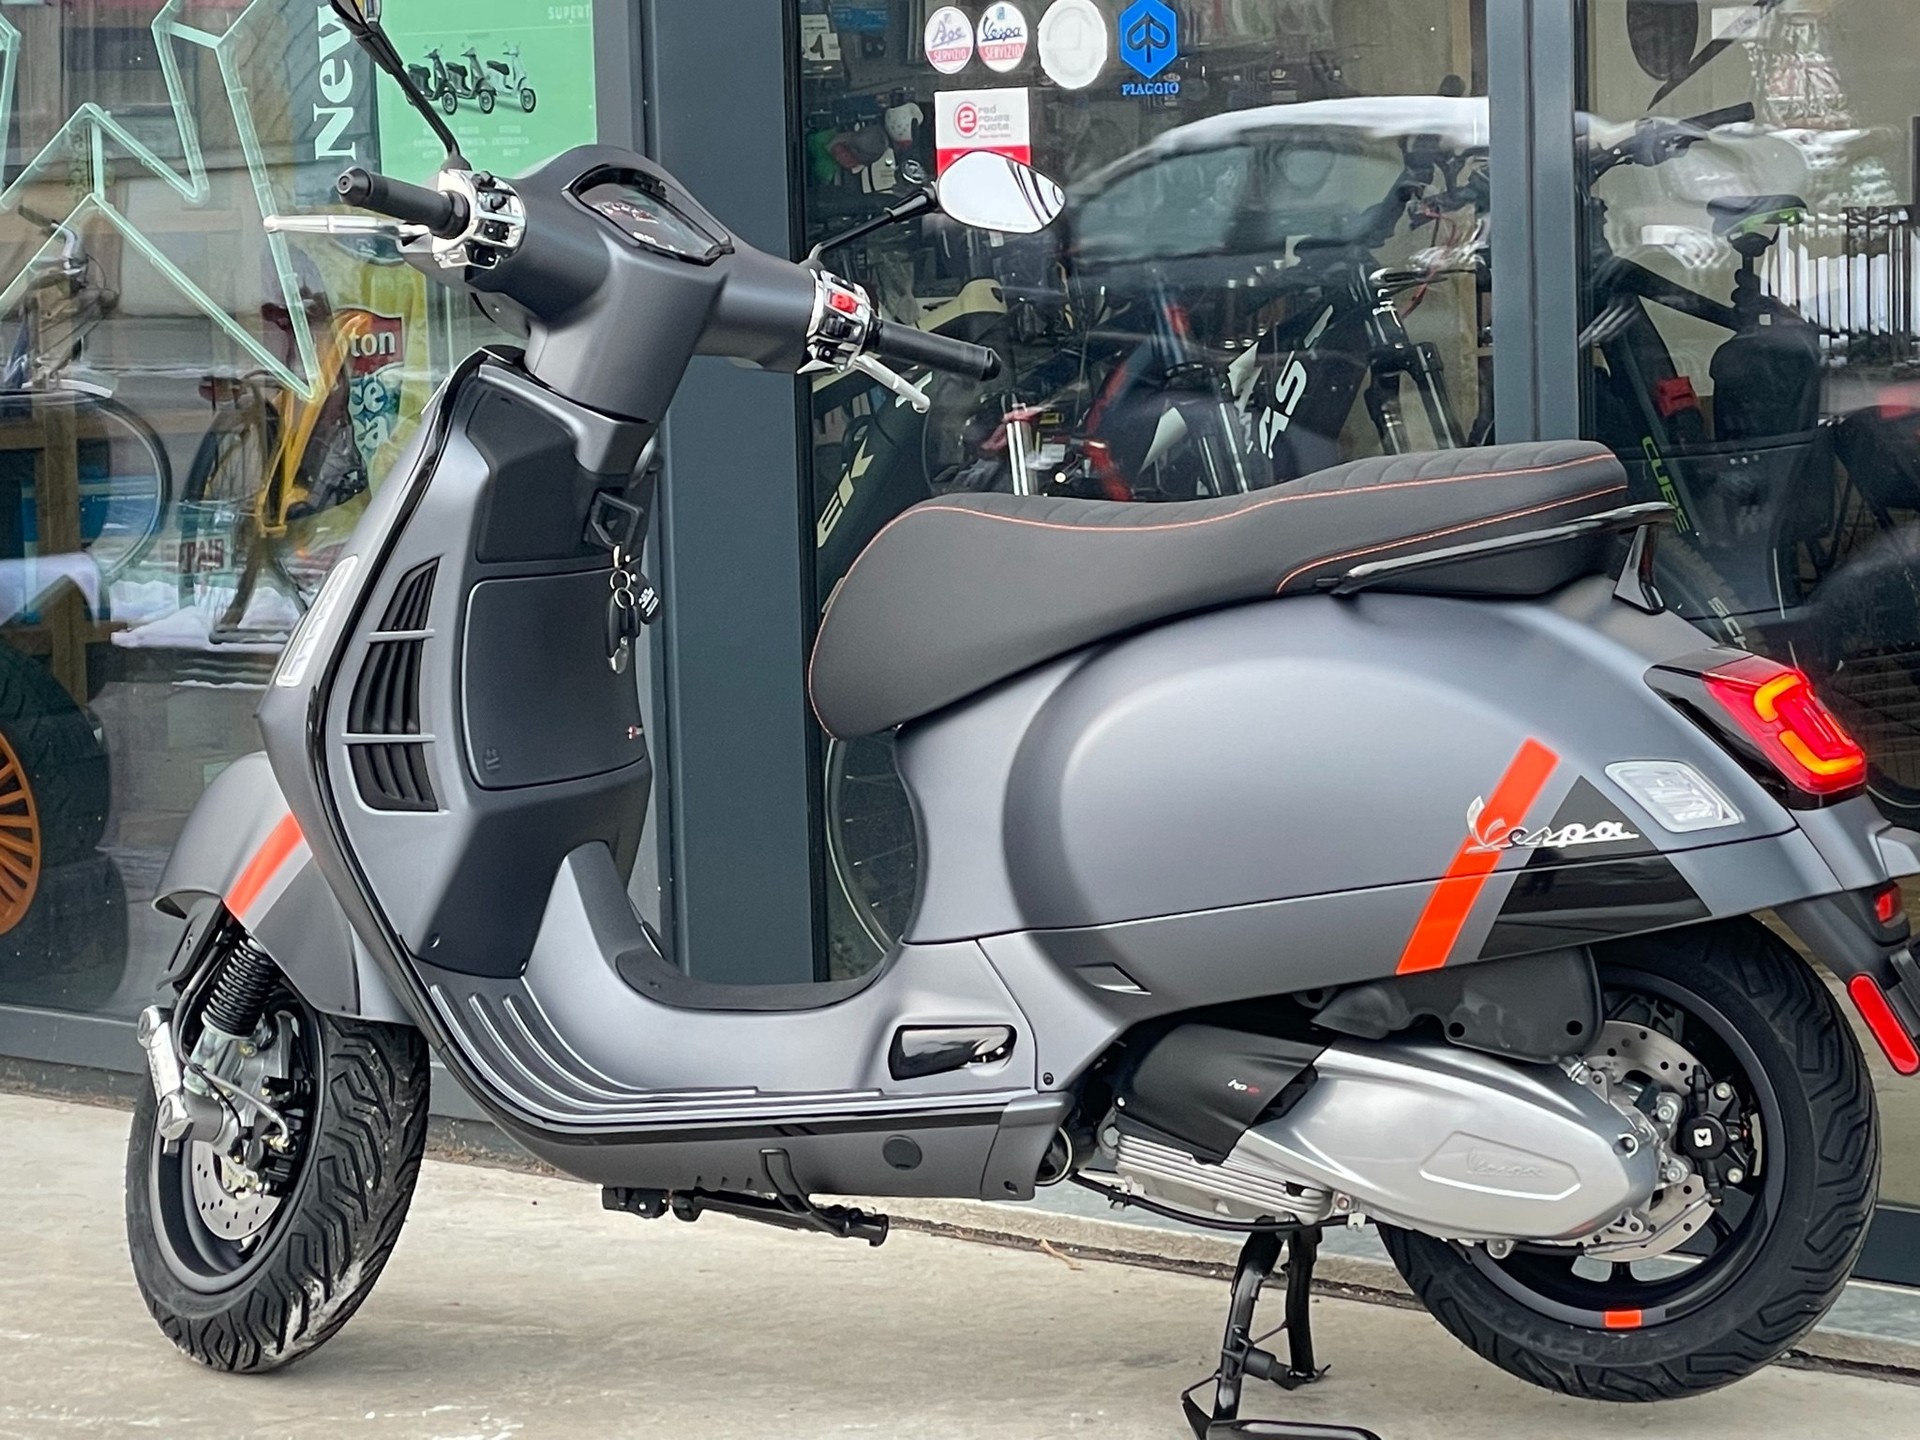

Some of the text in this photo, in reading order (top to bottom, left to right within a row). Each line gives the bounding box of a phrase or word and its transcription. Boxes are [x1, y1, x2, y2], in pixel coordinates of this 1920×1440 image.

[981, 16, 1023, 42] Vespa
[933, 48, 967, 62] SERVIZIO
[984, 45, 1022, 60] SERVIZIO
[1121, 82, 1179, 96] PIAGGIO
[349, 327, 396, 358] ton
[816, 436, 874, 548] EK
[1466, 795, 1640, 855] Vespa
